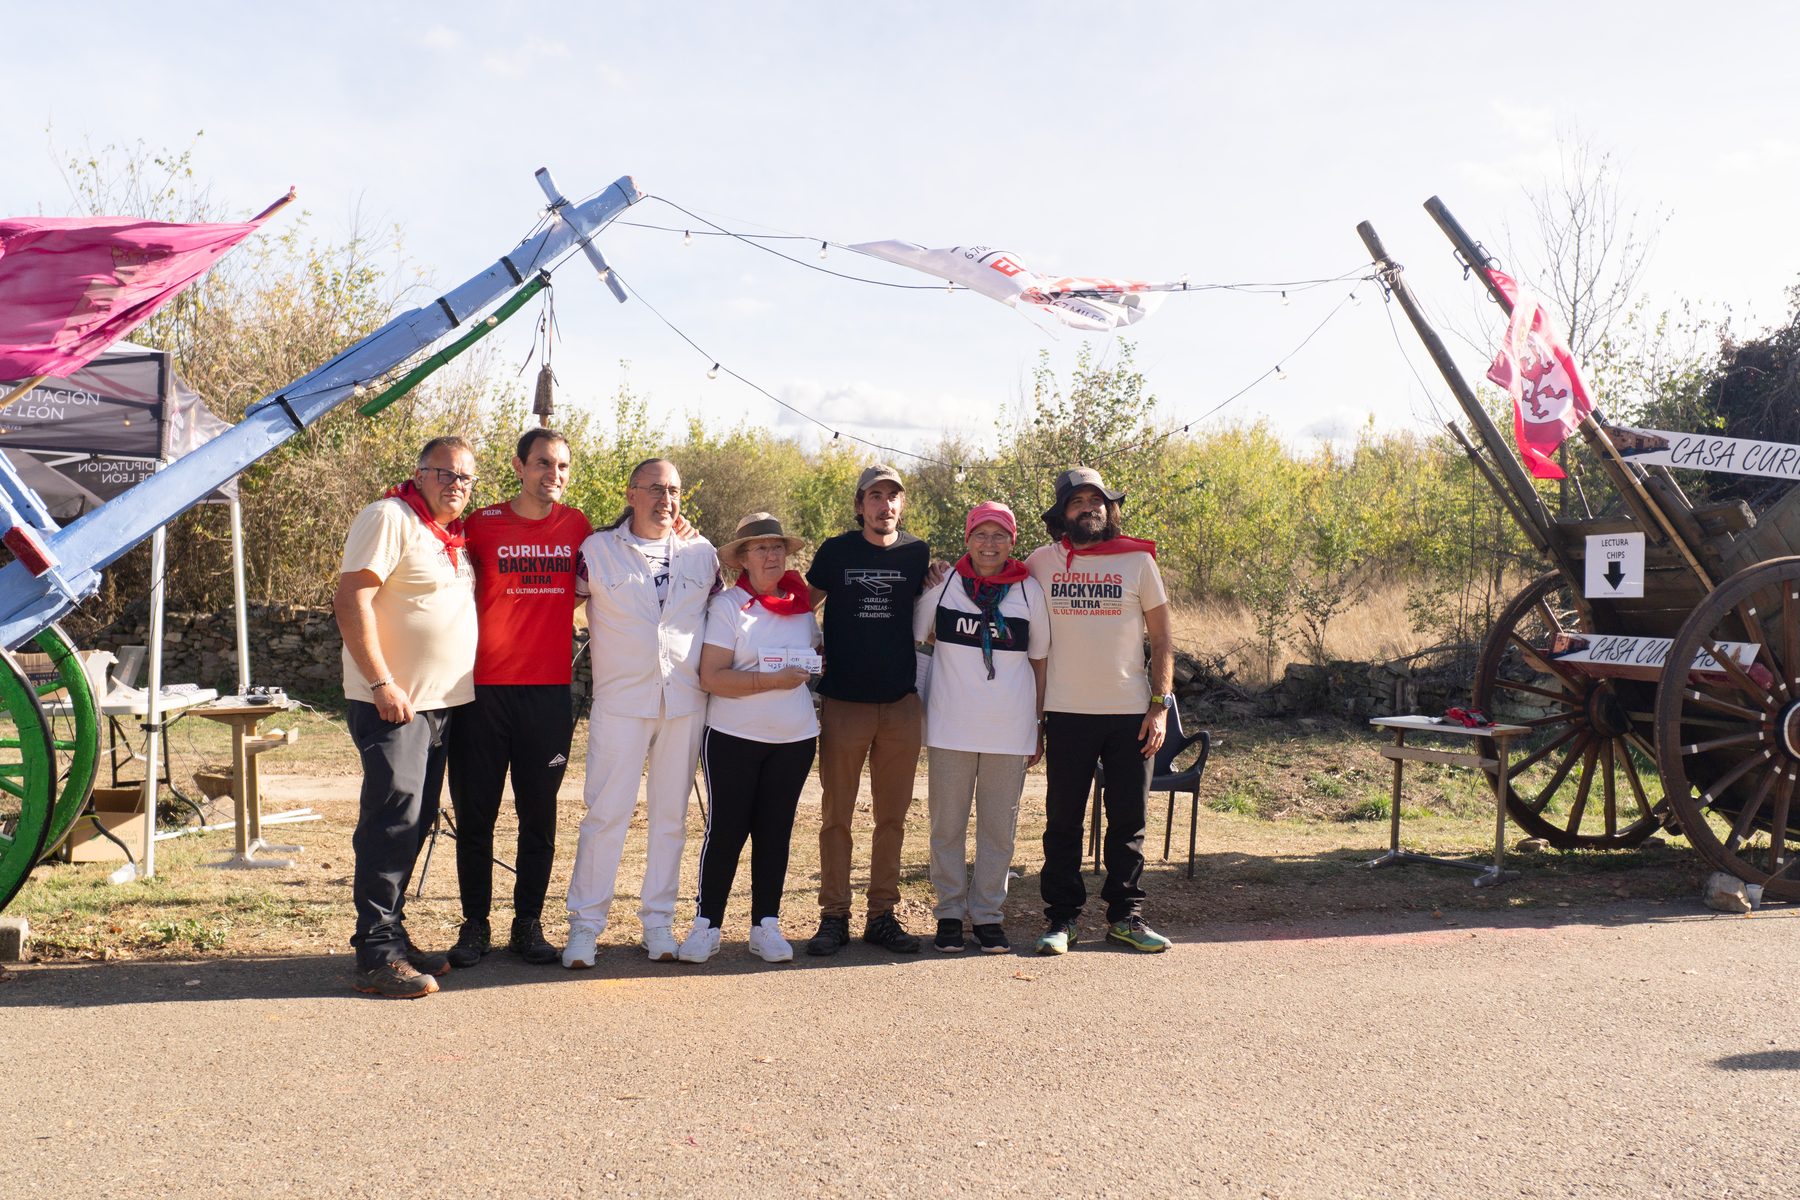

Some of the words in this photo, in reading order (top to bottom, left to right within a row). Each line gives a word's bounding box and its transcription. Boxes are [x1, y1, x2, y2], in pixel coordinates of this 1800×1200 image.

[0, 404, 13, 417] E
[17, 402, 65, 420] LEÓN
[1671, 437, 1736, 468] CASA
[1601, 538, 1629, 547] LECTURA
[497, 545, 572, 558] CURILLAS
[1606, 551, 1625, 560] CHIPS
[498, 557, 571, 574] BACKYARD
[521, 575, 552, 585] ULTRA
[1052, 572, 1123, 585] CURILLAS
[1051, 583, 1123, 599] BACKYARD
[1070, 599, 1101, 609] ULTRA
[1590, 637, 1639, 662] CASA
